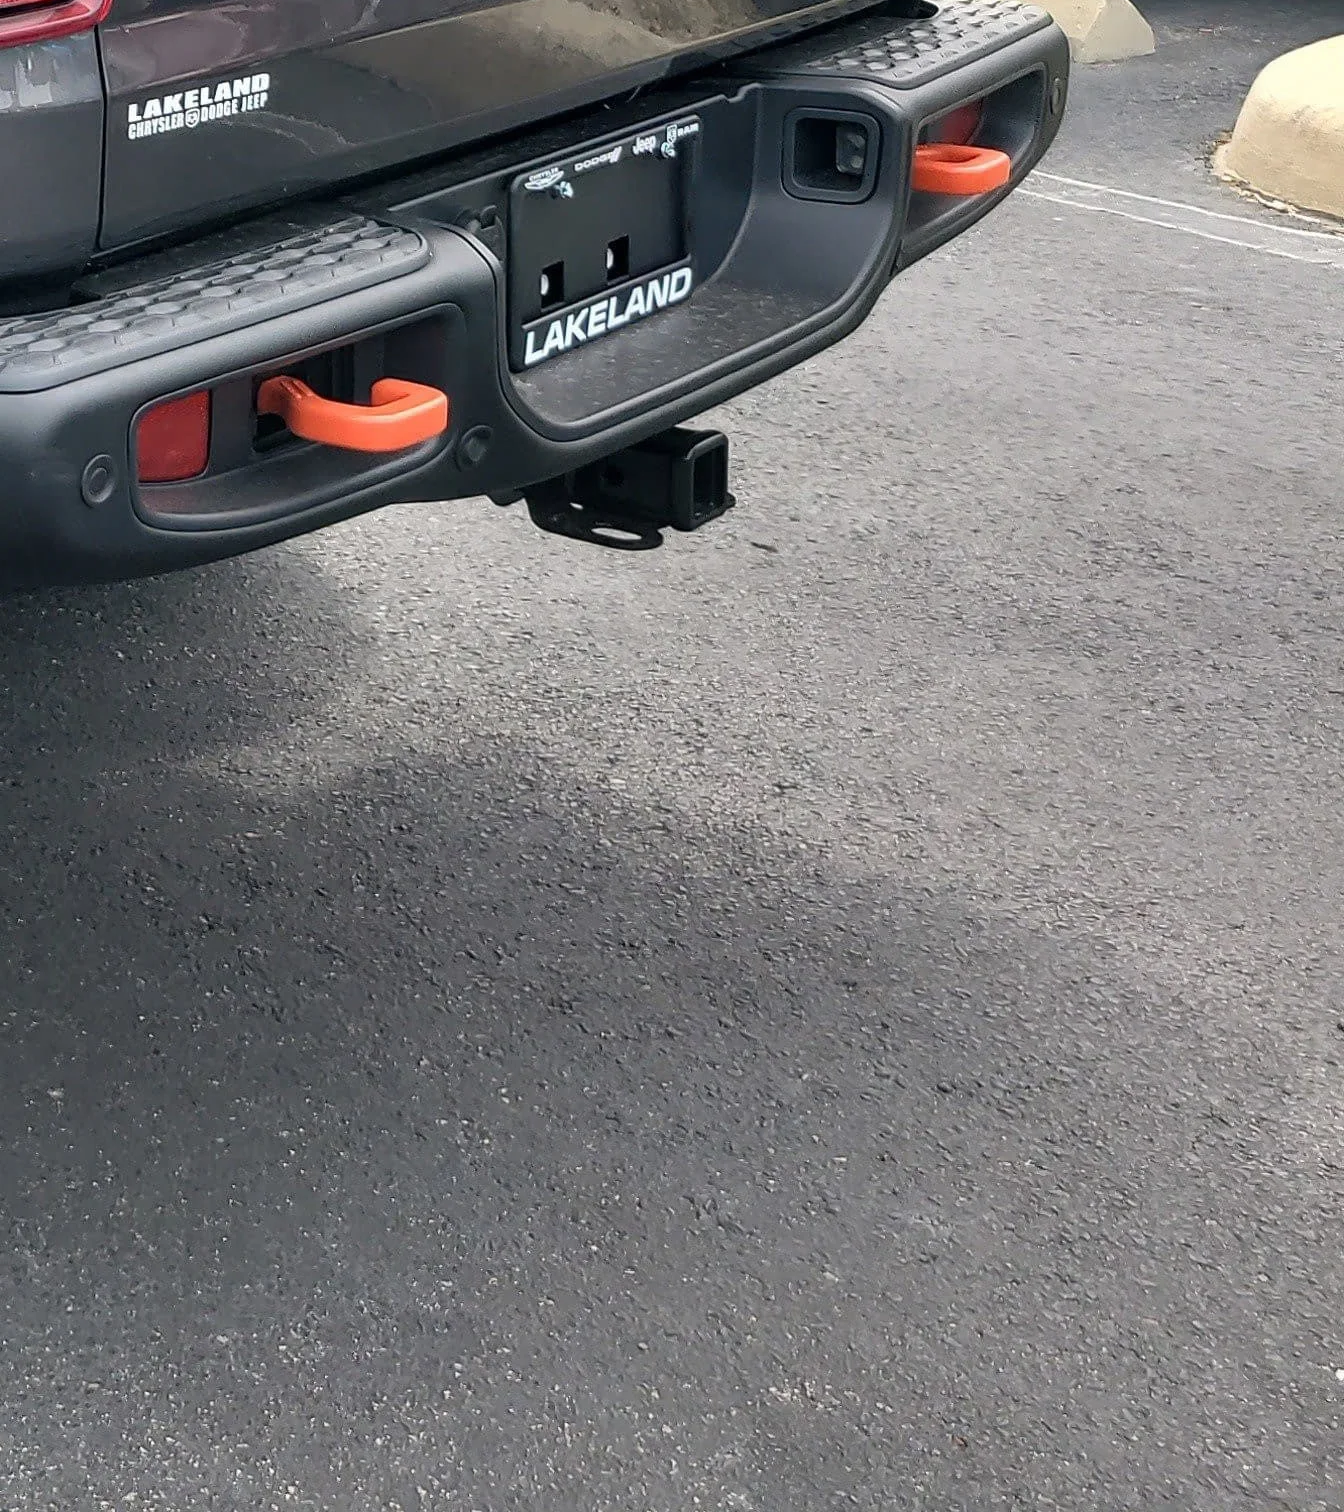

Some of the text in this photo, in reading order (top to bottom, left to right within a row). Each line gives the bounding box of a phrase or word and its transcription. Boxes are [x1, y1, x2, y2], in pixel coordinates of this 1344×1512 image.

[128, 73, 270, 122] LAKELAND
[128, 92, 268, 140] CHRYSLER DODGE JEEP
[632, 135, 656, 155] Jeep
[677, 122, 699, 137] RAM
[524, 267, 692, 365] LAKELAND
